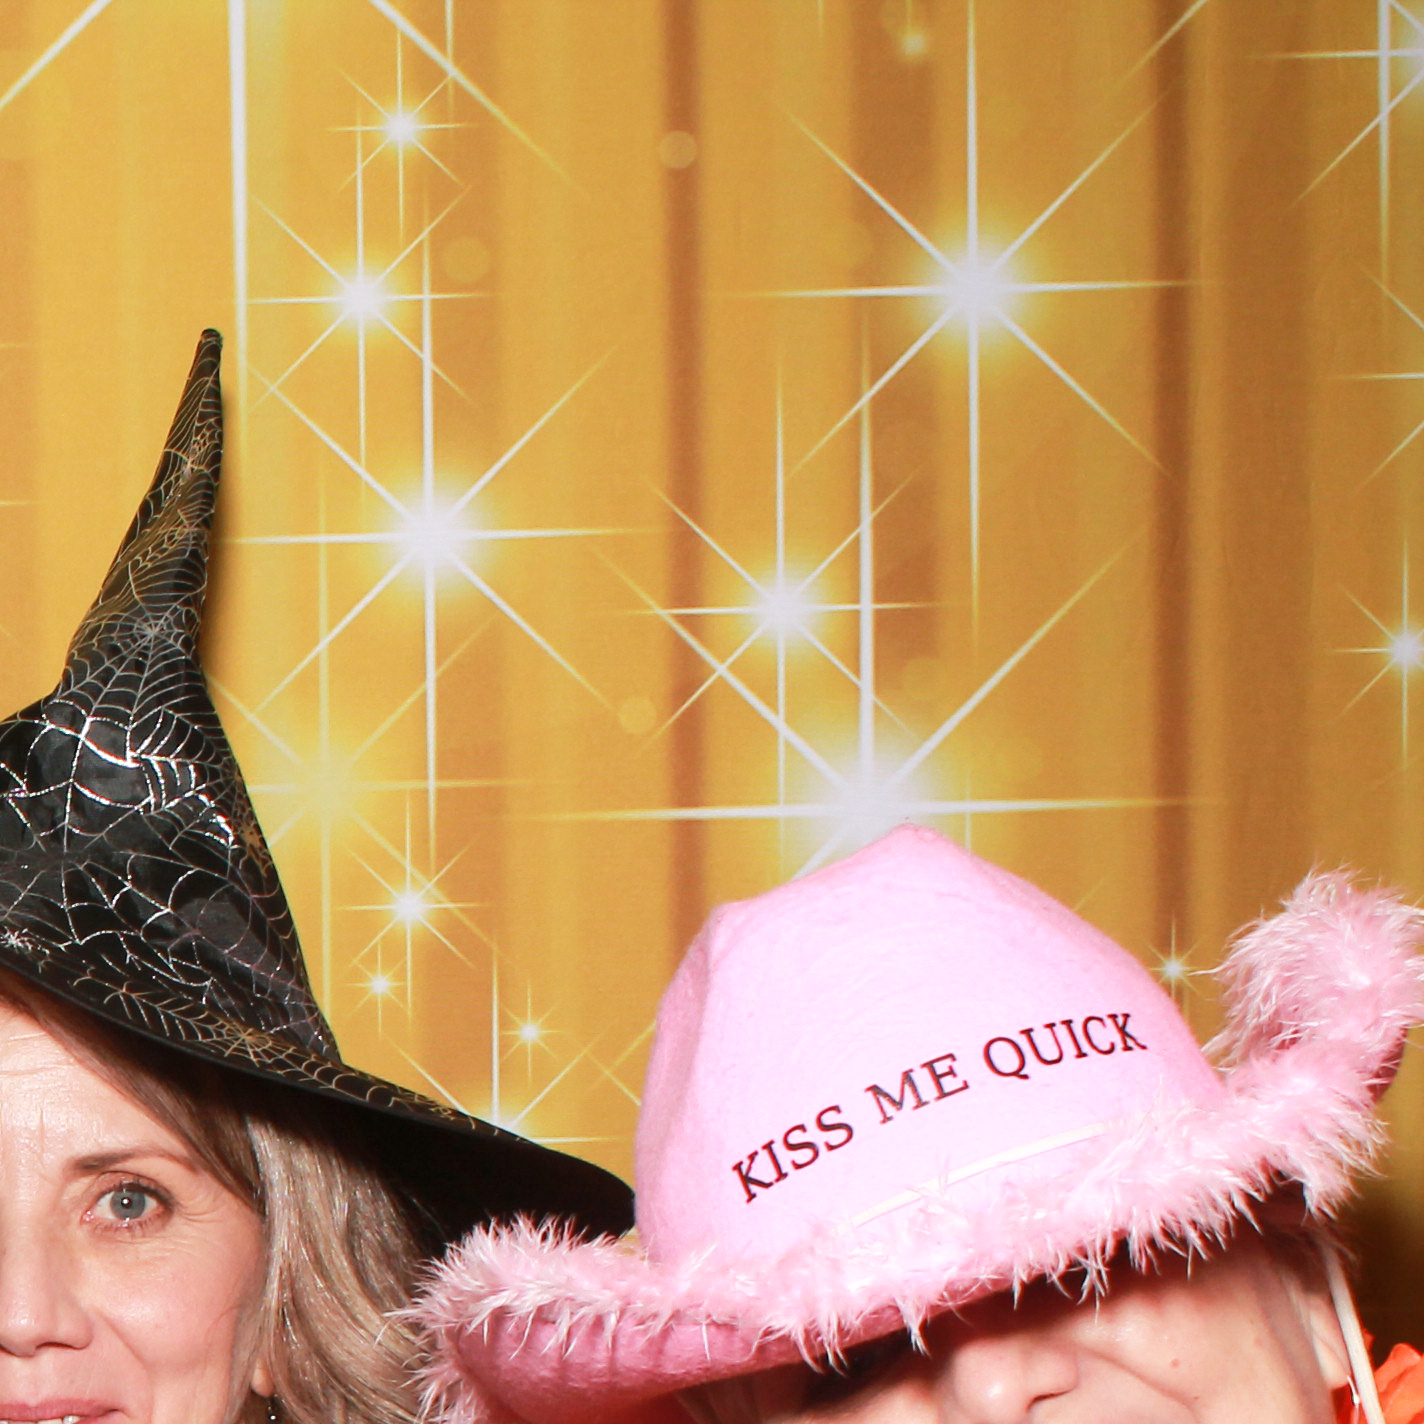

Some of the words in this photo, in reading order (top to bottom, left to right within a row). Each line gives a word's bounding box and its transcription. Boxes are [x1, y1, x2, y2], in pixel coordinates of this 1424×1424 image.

[731, 1105, 854, 1204] KISS
[864, 1052, 970, 1125] ME
[982, 1013, 1148, 1080] QUICK
